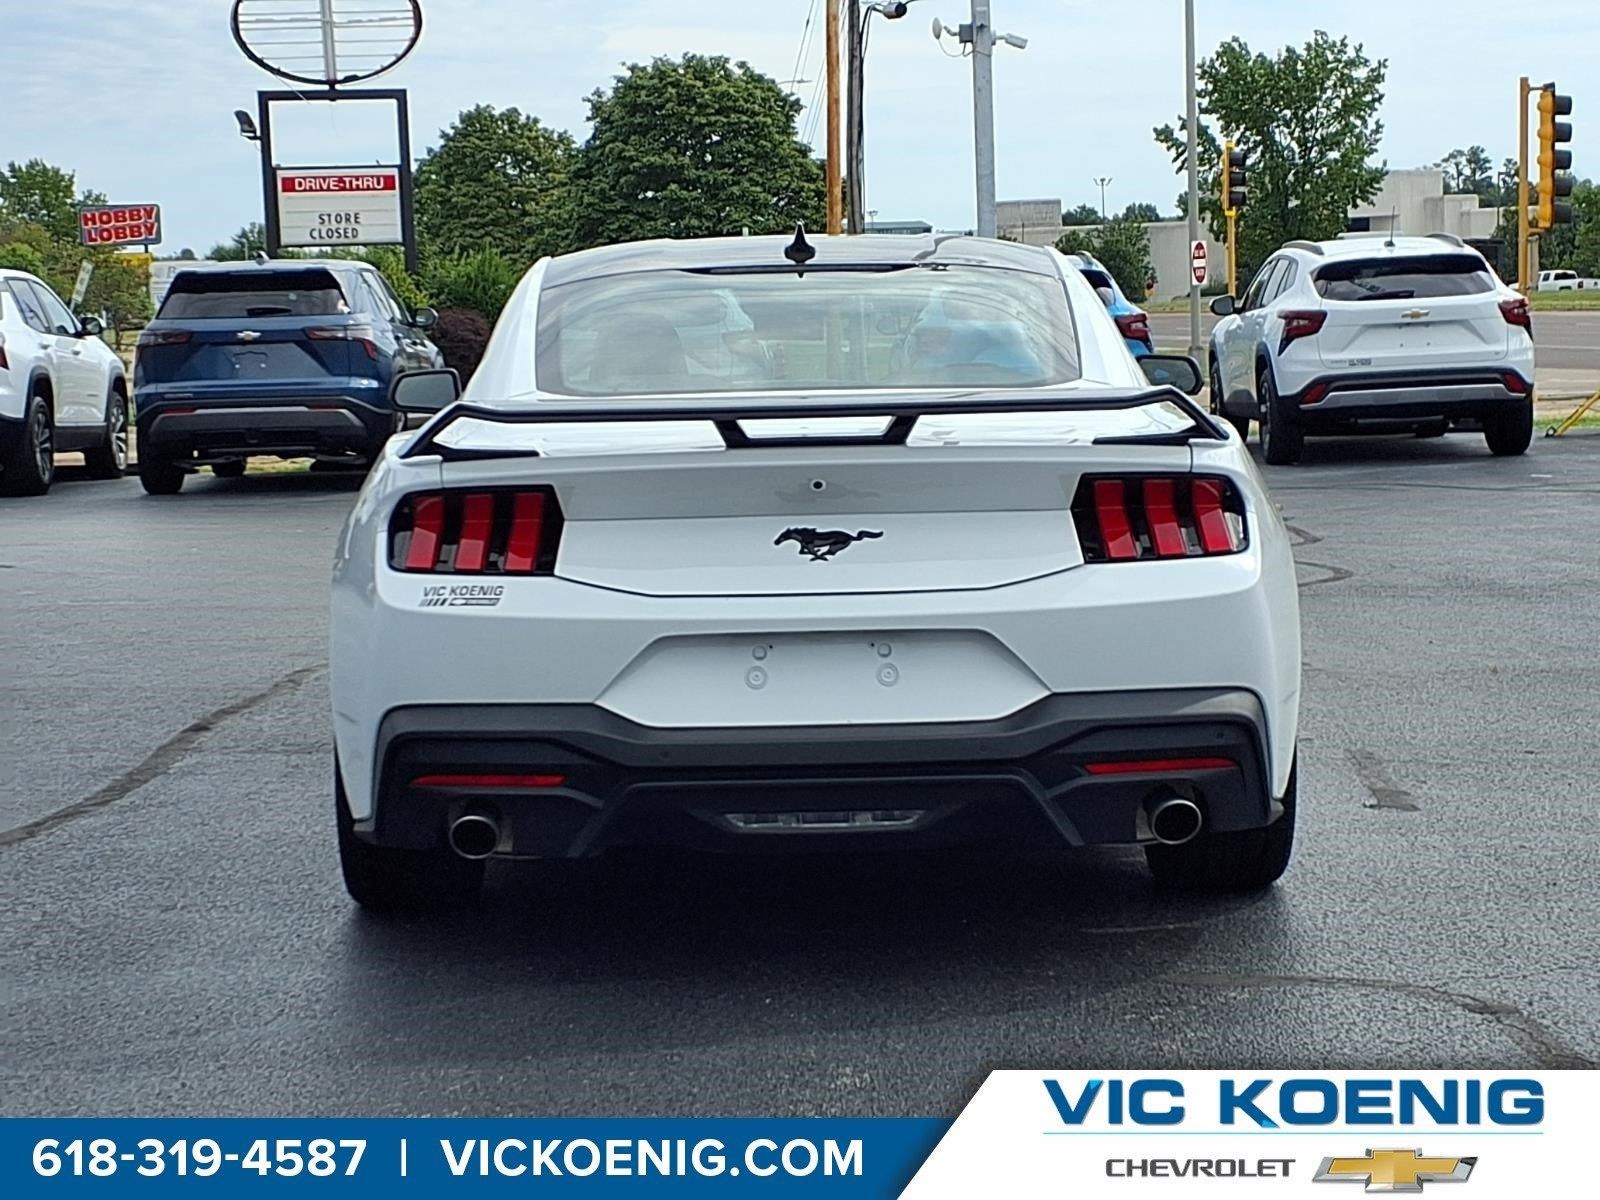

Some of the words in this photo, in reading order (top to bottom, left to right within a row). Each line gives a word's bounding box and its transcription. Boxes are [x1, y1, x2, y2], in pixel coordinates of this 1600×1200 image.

[294, 177, 384, 191] DRIVE-THRU
[82, 206, 156, 228] HOBBY
[318, 212, 361, 225] STORE
[87, 222, 157, 244] LOBBY
[309, 228, 359, 240] CLOSED
[423, 586, 446, 597] VIC
[449, 585, 504, 596] KOENIG
